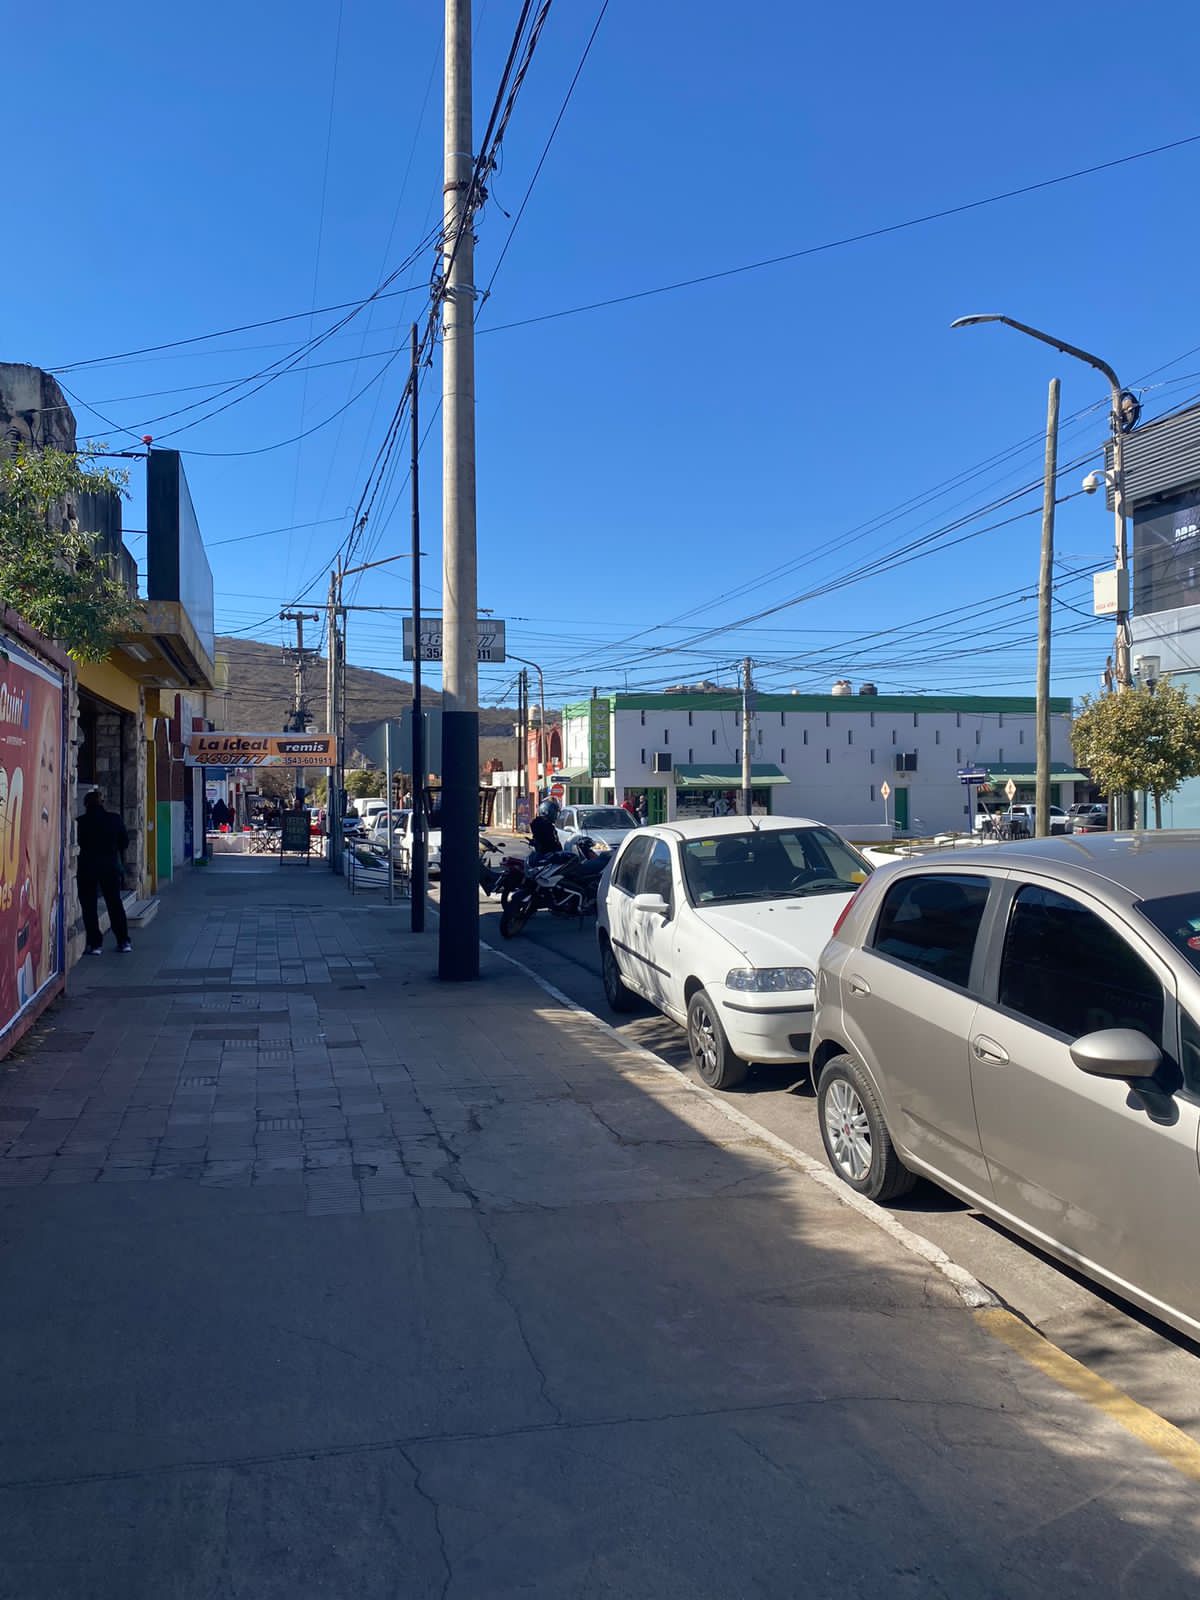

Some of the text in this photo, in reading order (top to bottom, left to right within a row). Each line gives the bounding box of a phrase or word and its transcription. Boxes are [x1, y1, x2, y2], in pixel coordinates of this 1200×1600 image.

[594, 703, 608, 769] AVENIDA
[198, 738, 219, 750] La
[286, 741, 325, 752] remis
[195, 752, 269, 765] 460777
